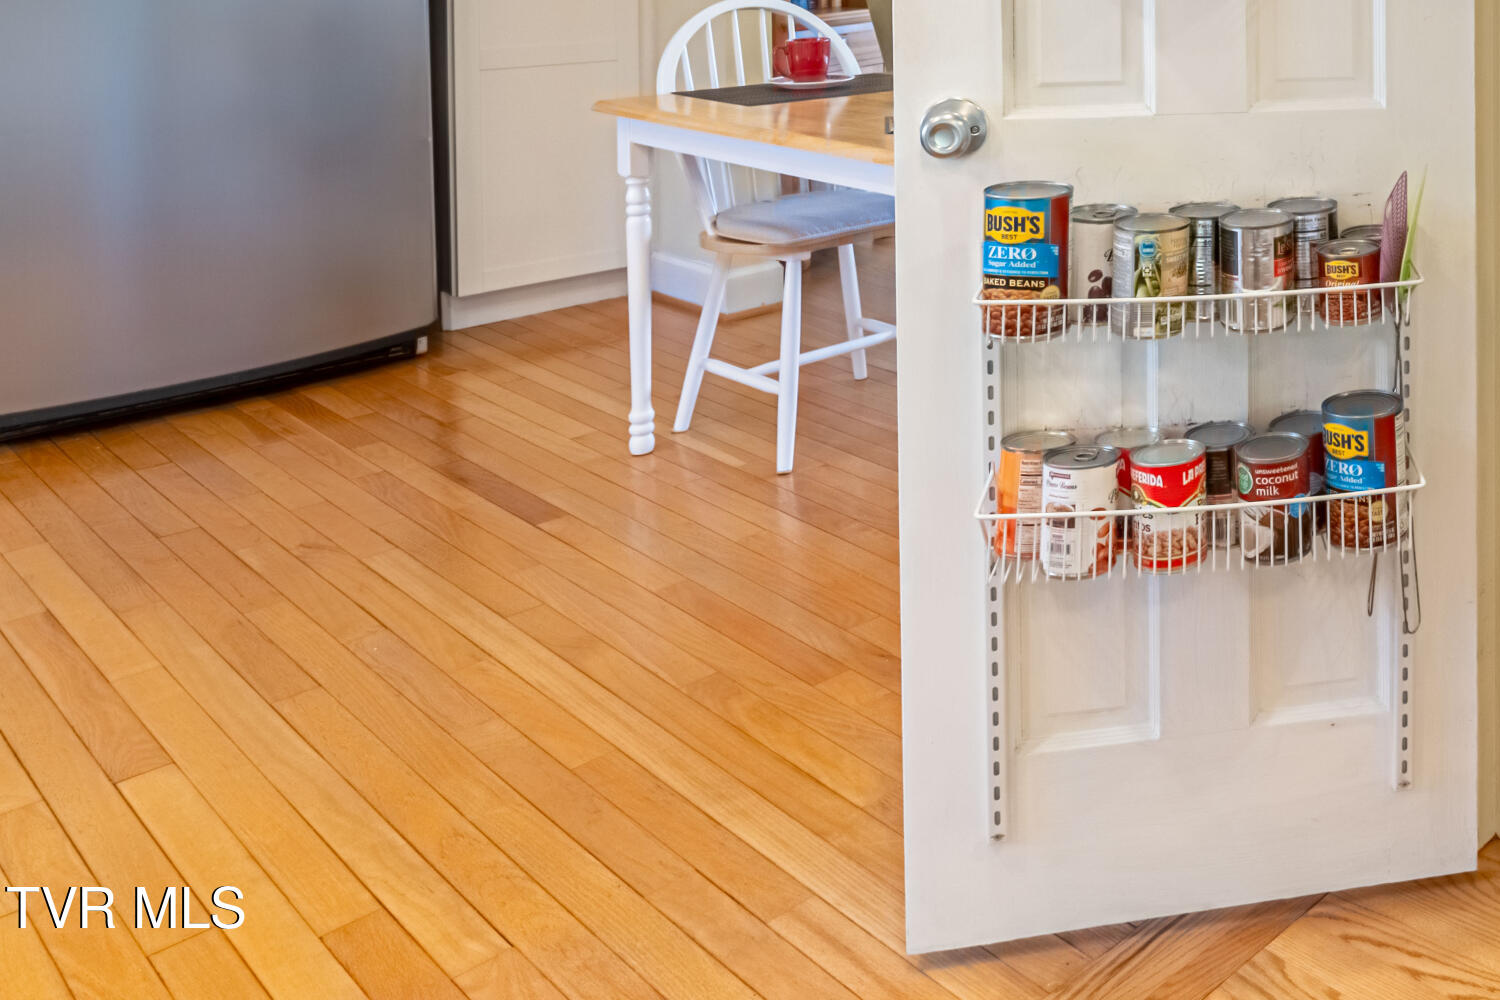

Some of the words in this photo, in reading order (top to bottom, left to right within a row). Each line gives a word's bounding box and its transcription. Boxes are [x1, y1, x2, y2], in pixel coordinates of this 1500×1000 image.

[987, 214, 1040, 234] BUSH'S
[988, 260, 1006, 268] Sugar
[1008, 260, 1036, 268] Added
[1327, 264, 1357, 275] BUSH'S
[1009, 279, 1045, 288] BEANS
[1255, 463, 1298, 474] unsweetened
[1256, 472, 1298, 485] coconut
[1256, 487, 1279, 496] milk
